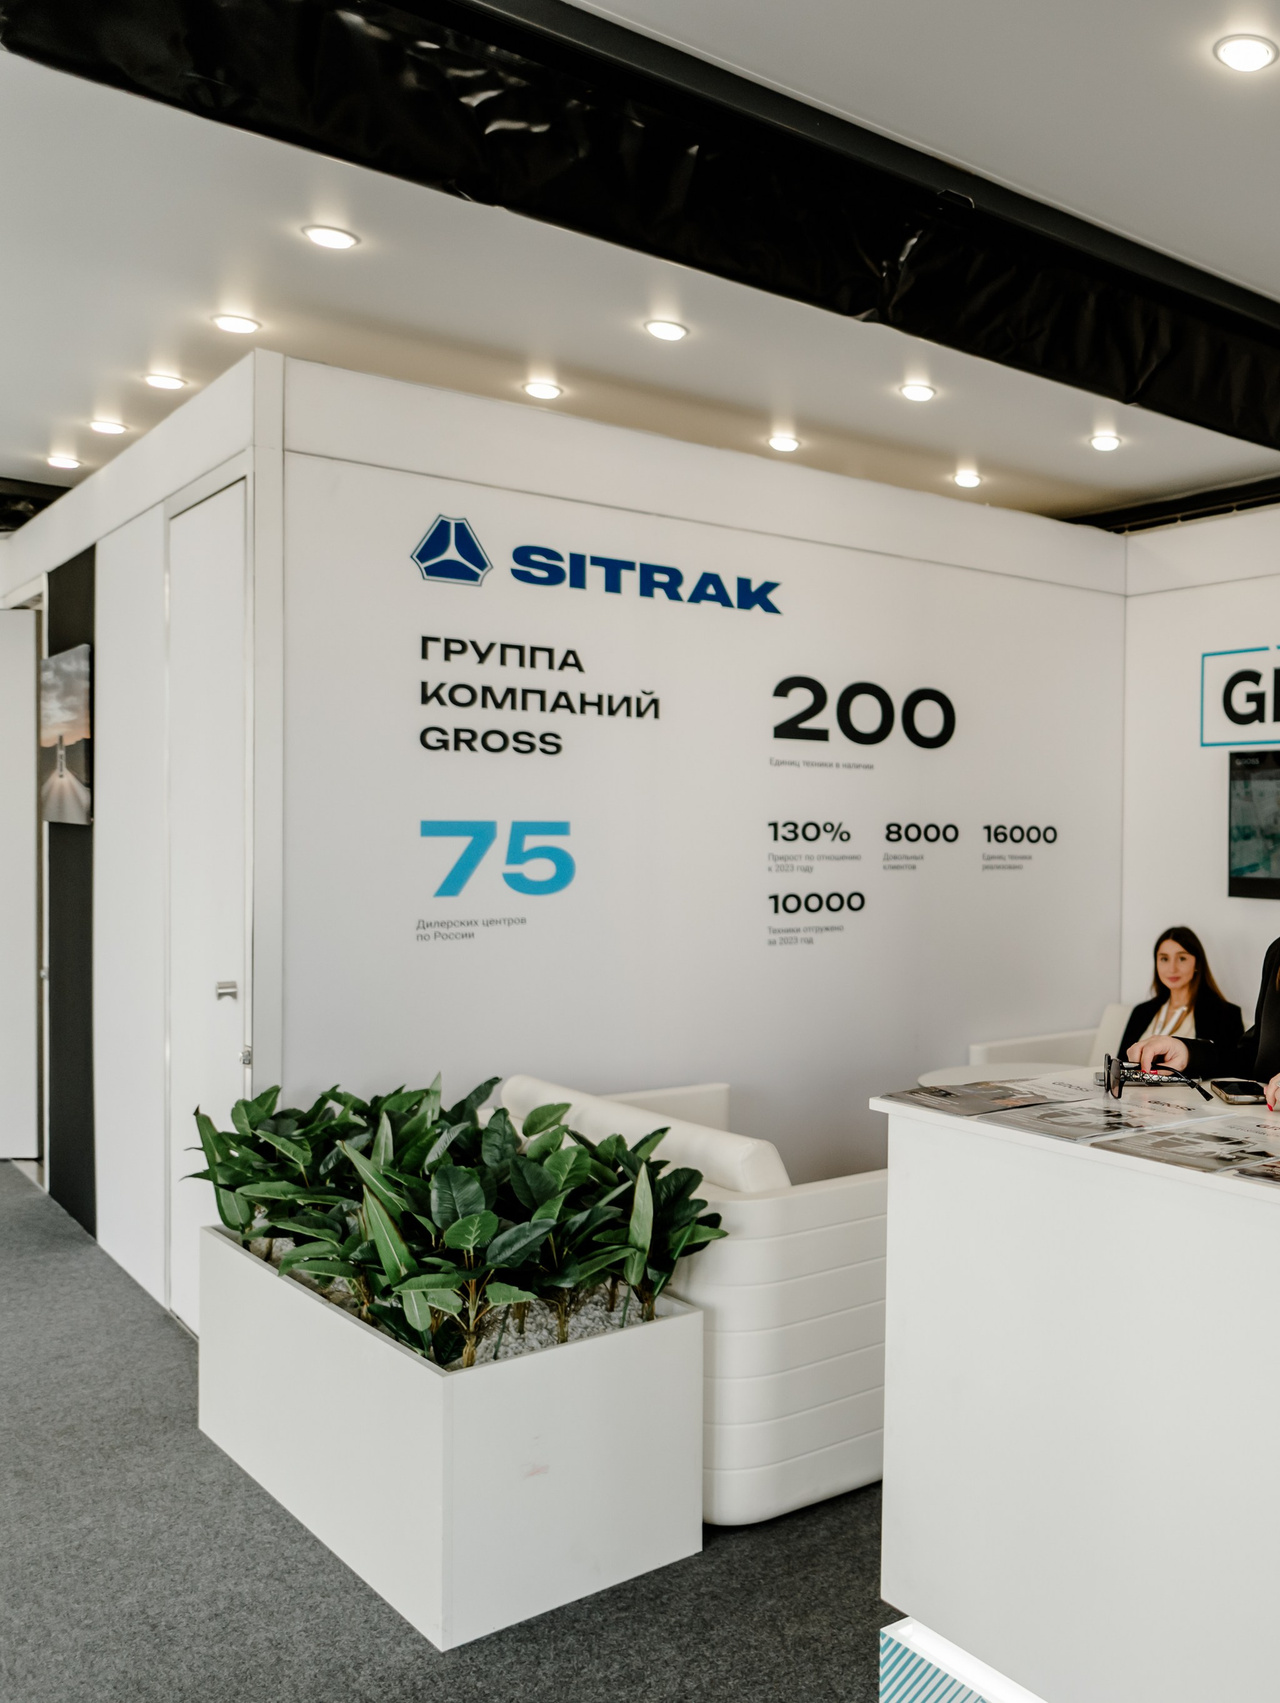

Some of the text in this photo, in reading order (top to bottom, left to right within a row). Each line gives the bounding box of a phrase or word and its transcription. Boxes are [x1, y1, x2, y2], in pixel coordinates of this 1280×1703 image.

[510, 544, 783, 615] SITRAK
[420, 635, 585, 673] ГРУППА
[420, 681, 661, 719] КОМПАНИЙ
[773, 675, 956, 749] 200
[419, 726, 563, 755] GROSS
[767, 821, 851, 842] 130%
[885, 822, 960, 843] 8000
[983, 824, 1058, 844] 16000
[420, 820, 577, 898] 75
[775, 863, 794, 873] 2023
[767, 891, 866, 914] 10000
[416, 916, 527, 931] Дилерских центров
[416, 931, 475, 942] по России
